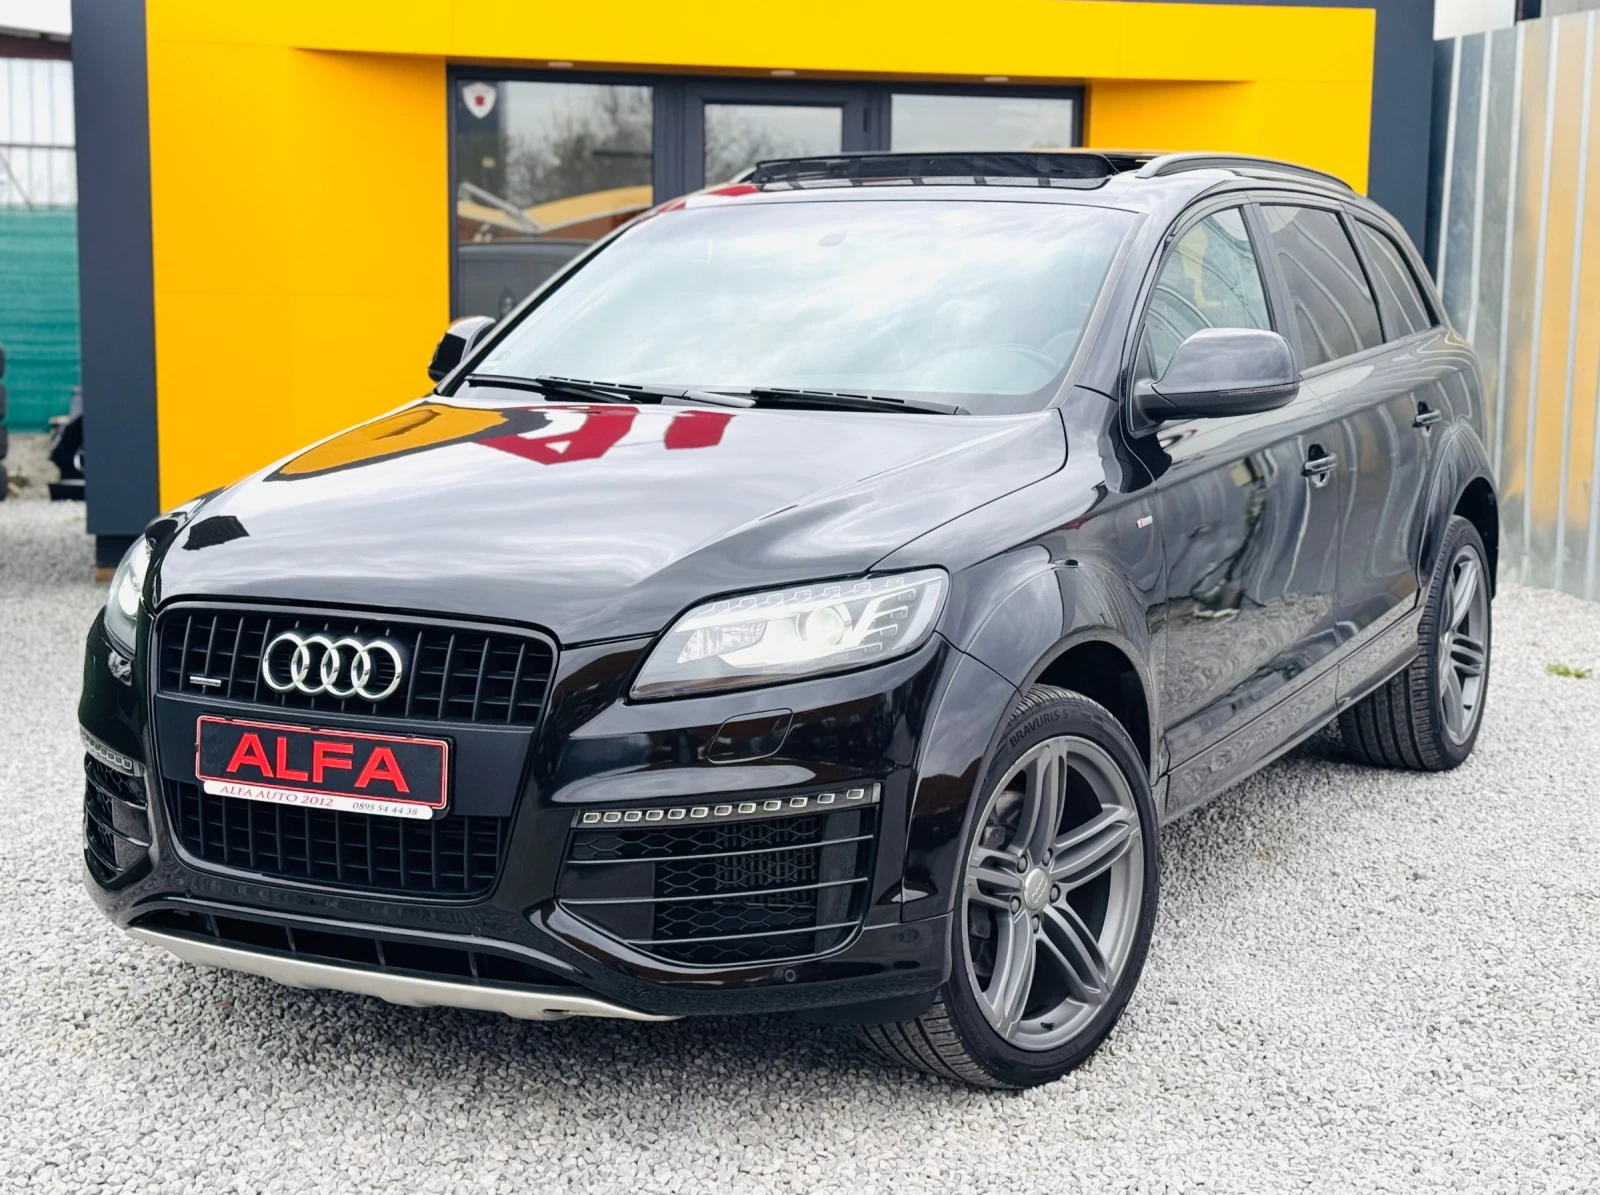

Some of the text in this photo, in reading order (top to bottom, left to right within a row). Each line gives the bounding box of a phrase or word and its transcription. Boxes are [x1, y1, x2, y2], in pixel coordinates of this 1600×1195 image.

[1009, 709, 1069, 748] BRAVURIS 5
[226, 732, 410, 793] ALFA
[220, 785, 333, 807] ALFA AUTO 2012
[352, 802, 418, 816] 0895 54 44 38
